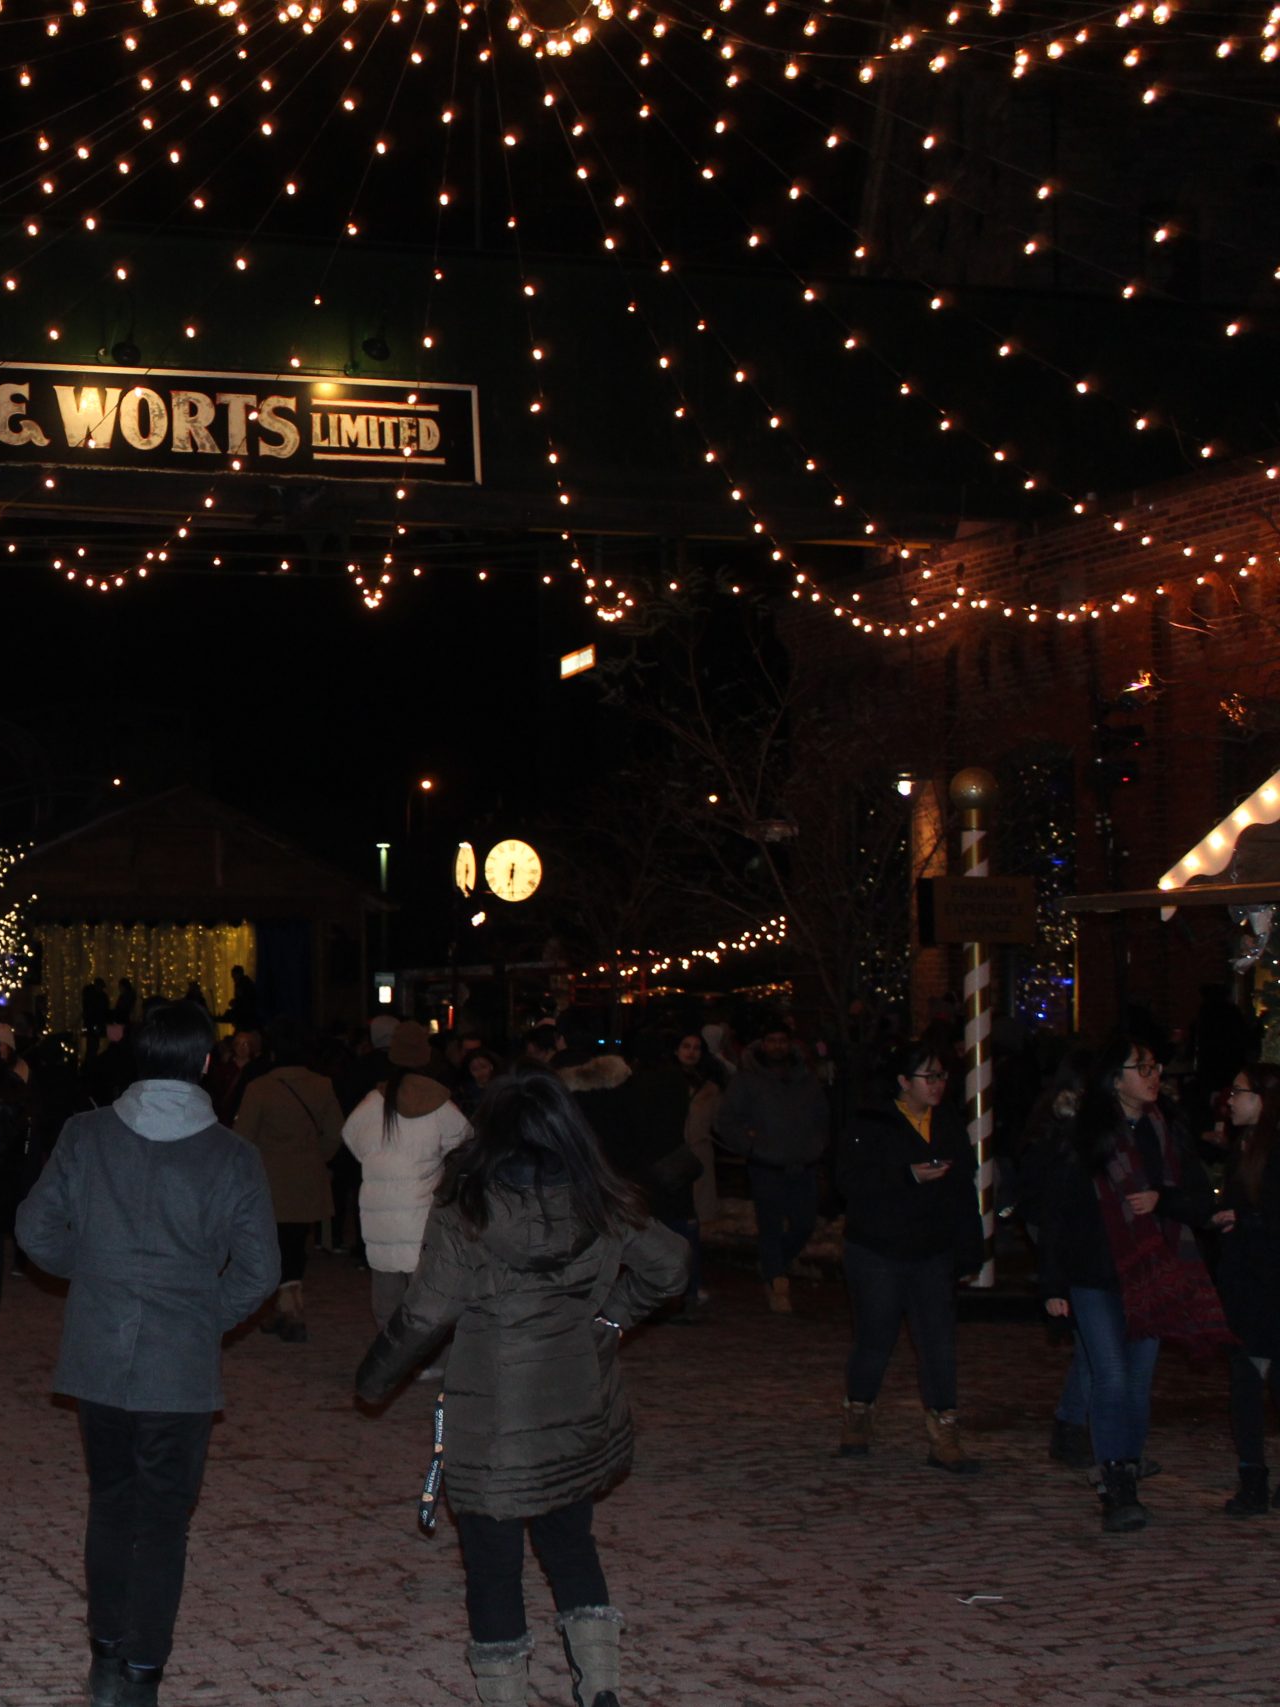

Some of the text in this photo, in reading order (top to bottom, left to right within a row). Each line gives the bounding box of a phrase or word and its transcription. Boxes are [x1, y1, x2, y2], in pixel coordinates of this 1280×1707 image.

[53, 384, 301, 459] WORTS
[311, 412, 441, 452] LIMITED
[426, 1460, 439, 1493] WATERLOO
